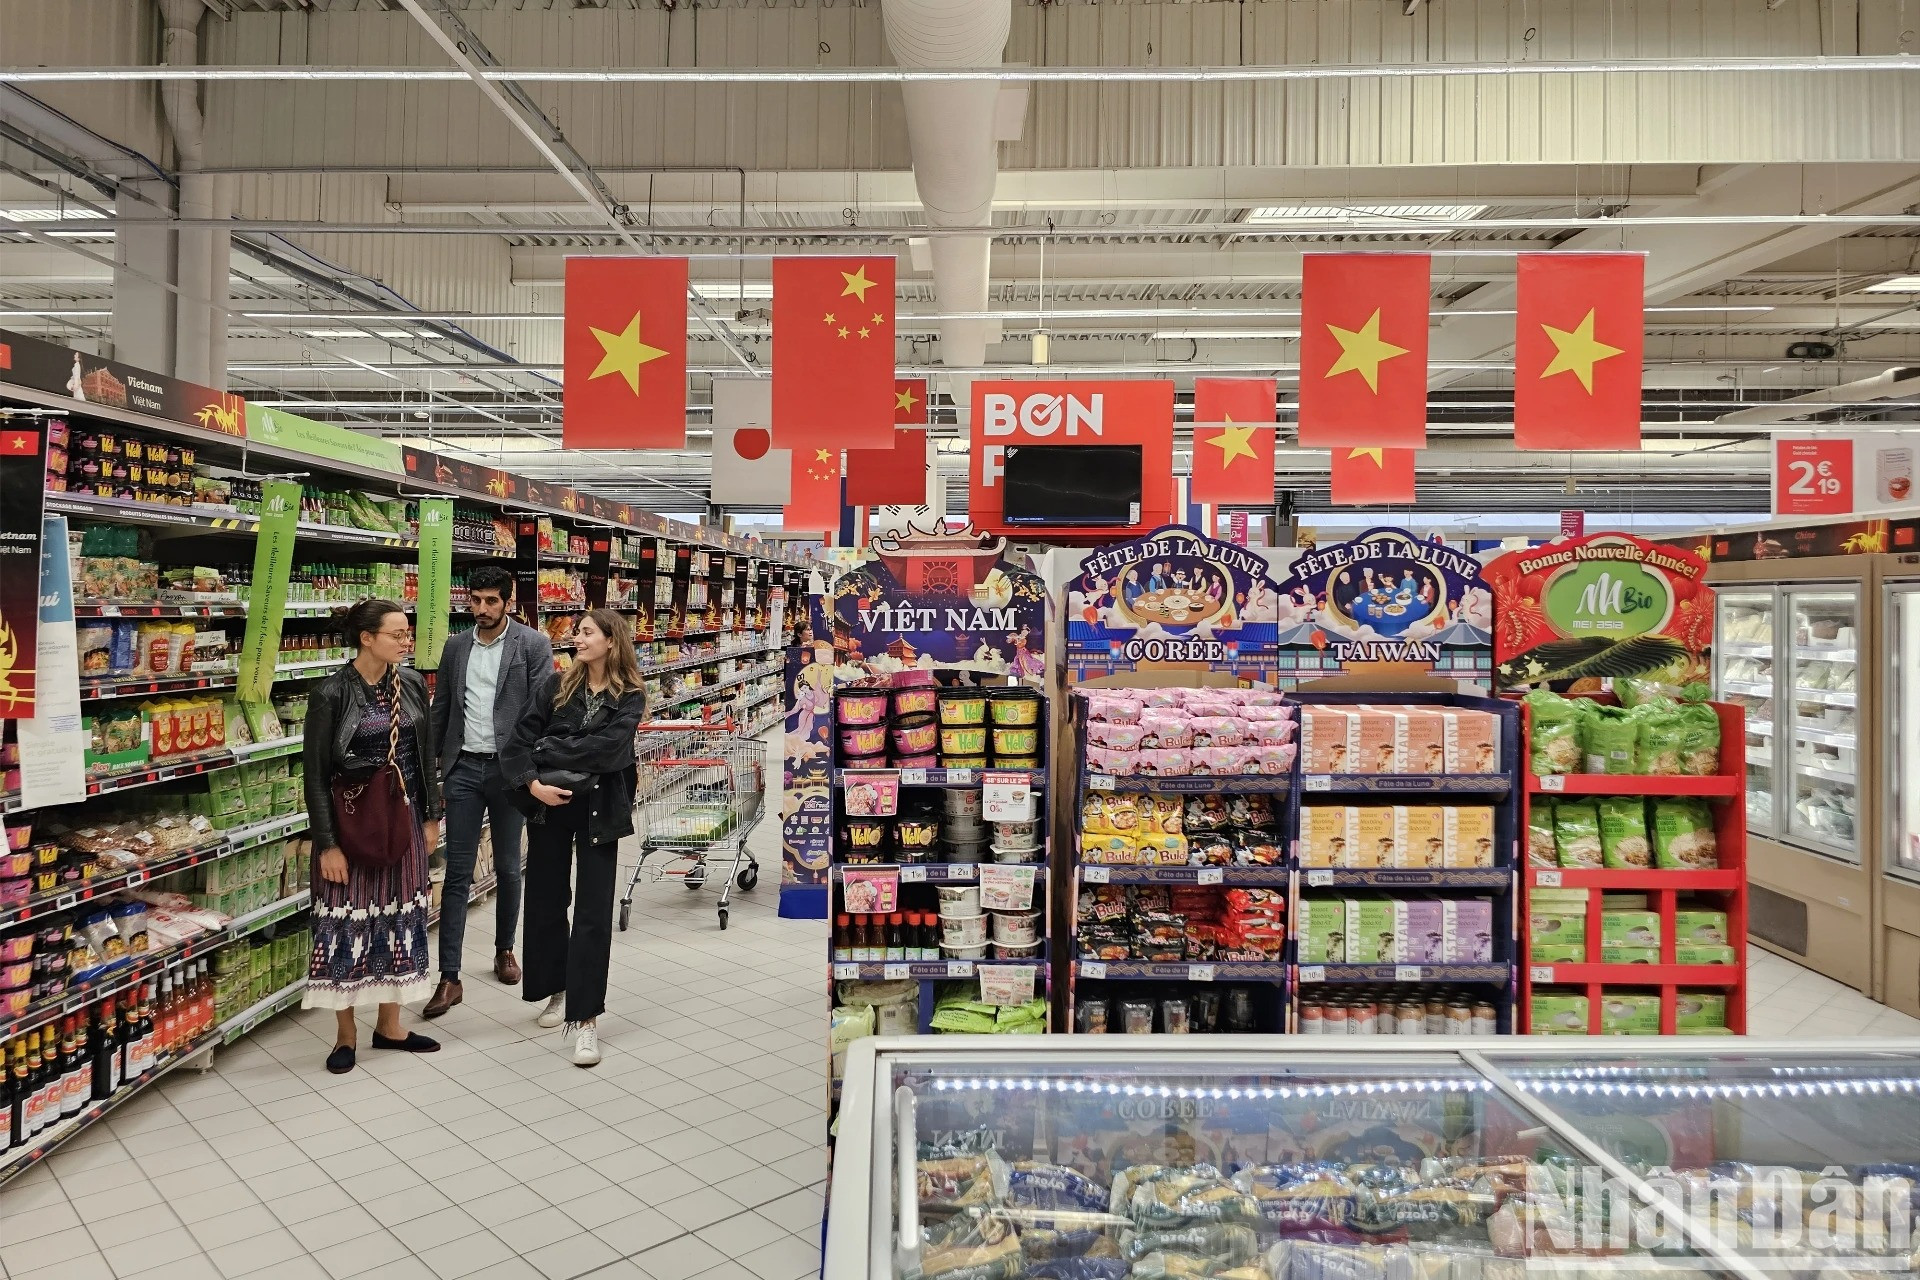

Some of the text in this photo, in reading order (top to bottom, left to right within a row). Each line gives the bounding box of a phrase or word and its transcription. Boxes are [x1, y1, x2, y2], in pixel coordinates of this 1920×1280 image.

[127, 376, 163, 395] Vietnam
[145, 399, 161, 410] Nam
[984, 393, 1103, 437] BON
[1084, 540, 1265, 579] FÊTE DE LA LUNE
[1295, 541, 1478, 581] FÊTE DE LA LUNE
[1519, 545, 1699, 579] Bonne Nouvelle Année!
[263, 585, 272, 614] Saveurs
[1620, 587, 1653, 613] Bio
[262, 615, 268, 624] de
[956, 607, 1018, 632] NAM
[254, 646, 263, 664] pour
[1126, 635, 1224, 662] CORÉE
[1331, 642, 1442, 662] TAIWAN
[1160, 781, 1211, 789] Fête de la Lune
[1379, 780, 1395, 788] Fête
[1158, 870, 1191, 878] Fête de la
